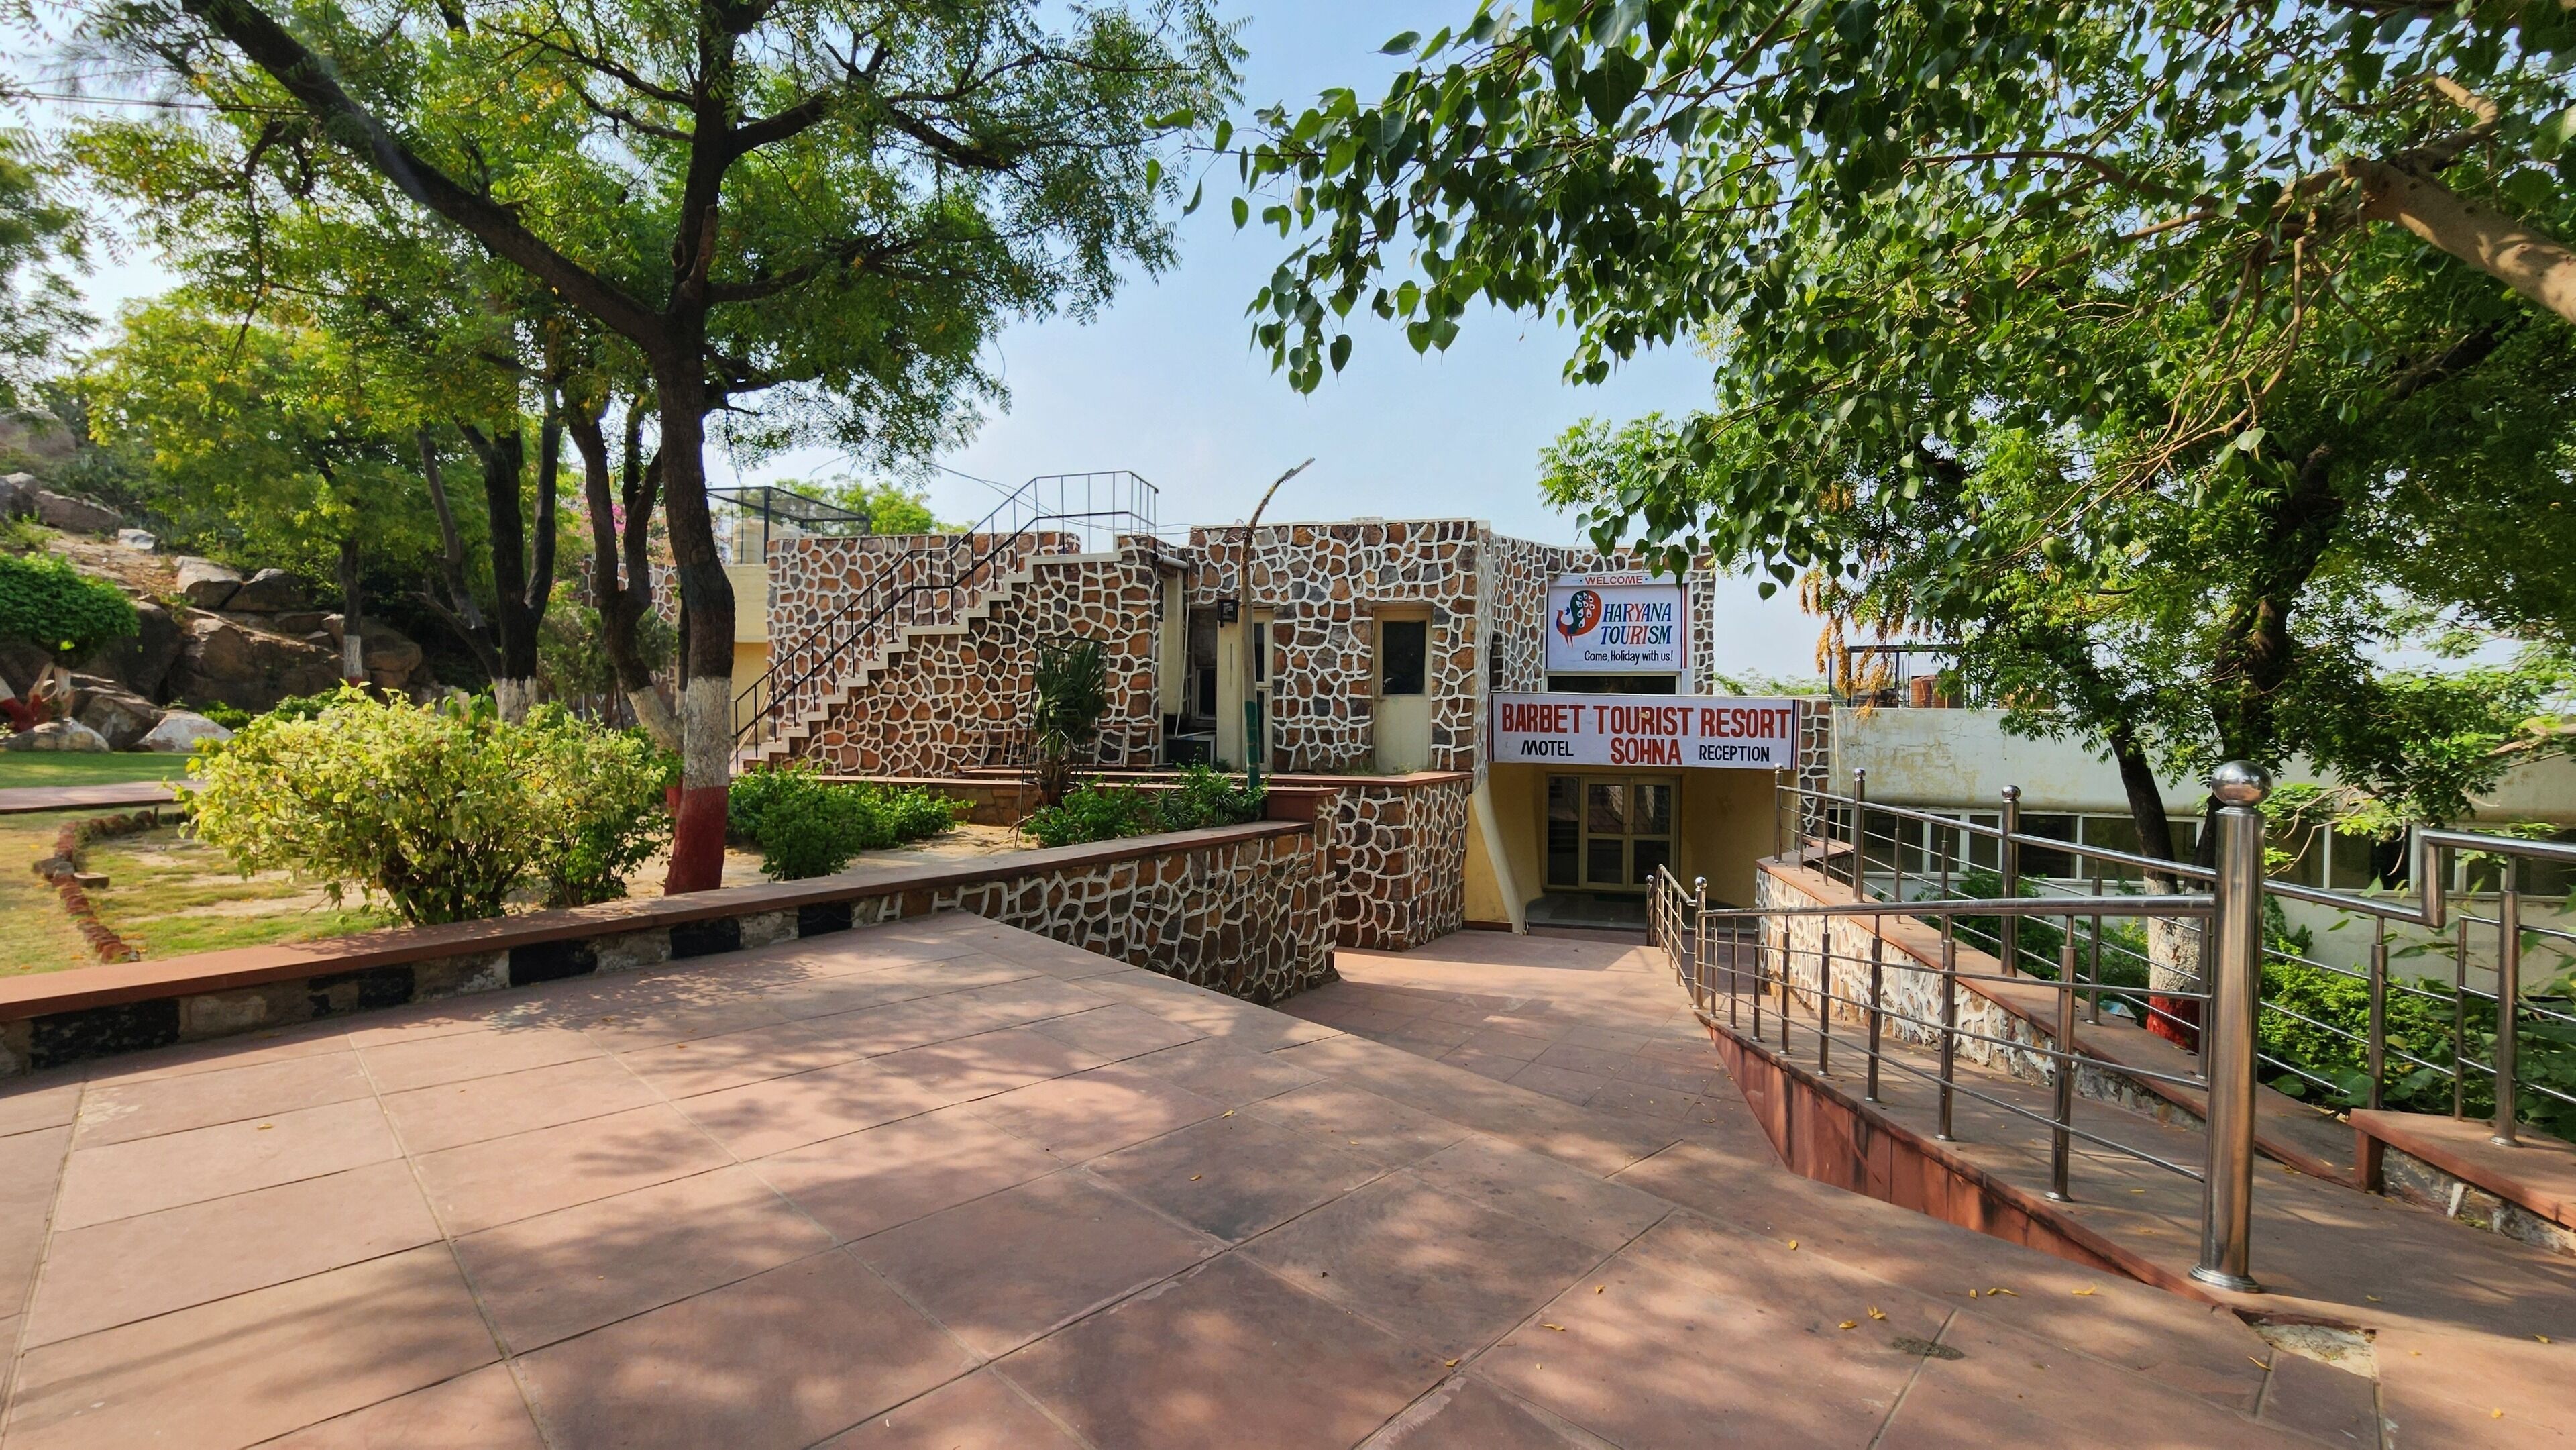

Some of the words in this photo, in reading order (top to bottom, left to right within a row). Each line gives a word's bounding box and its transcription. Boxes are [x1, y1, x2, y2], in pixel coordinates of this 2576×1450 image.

[1585, 576, 1642, 584] WELCOME
[1601, 603, 1672, 623] HARYANA
[1601, 625, 1672, 645] TOURISM
[1584, 650, 1610, 662] Come,
[1611, 650, 1640, 665] Holiday
[1642, 650, 1660, 661] with
[1660, 650, 1673, 661] us!
[1501, 703, 1586, 733] BARBET
[1593, 705, 1694, 735] TOURIST
[1699, 708, 1792, 739] RESORT
[1521, 740, 1574, 756] MOTEL
[1611, 737, 1682, 765] SOHNA
[1699, 745, 1770, 762] RECEPTION
